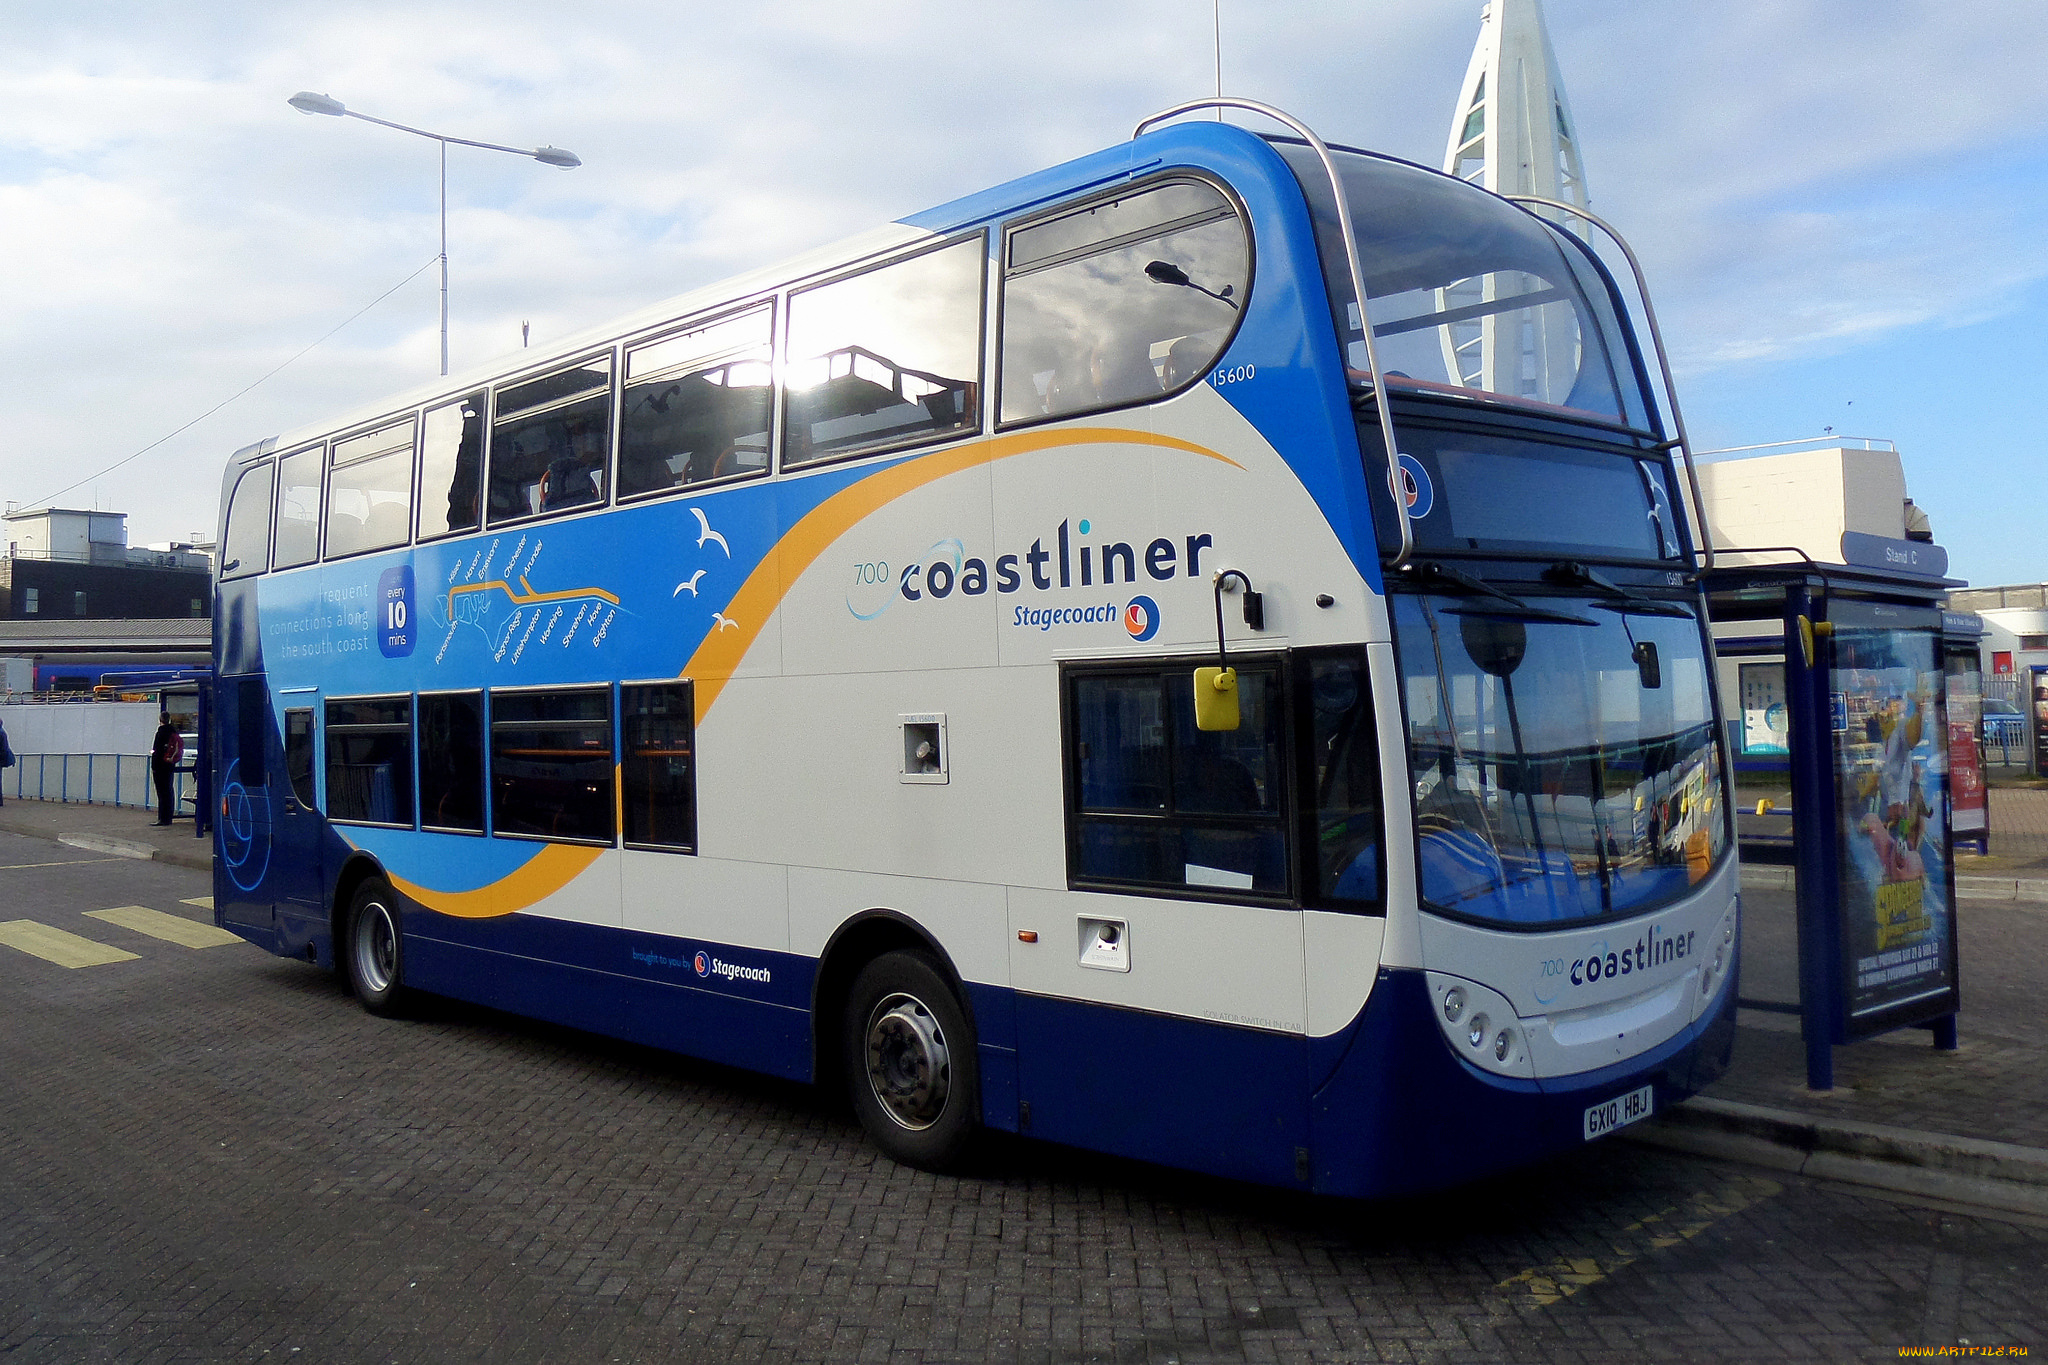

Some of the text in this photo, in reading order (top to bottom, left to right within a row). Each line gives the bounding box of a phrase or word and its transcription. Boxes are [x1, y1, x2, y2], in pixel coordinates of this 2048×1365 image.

[1213, 363, 1255, 387] 15600
[465, 550, 481, 582] Havant
[478, 538, 500, 580] Emsworth
[503, 534, 527, 579] Chichester
[524, 539, 543, 577] Arundel
[853, 517, 1214, 602] 700 coastliner
[1886, 547, 1918, 565] Stand C
[320, 582, 368, 606] frequent
[387, 586, 406, 599] every
[270, 606, 368, 635] connections along
[388, 601, 408, 629] 10
[539, 605, 563, 645] Worthing
[562, 603, 588, 648] Shoreham
[587, 602, 602, 627] Hove
[592, 609, 616, 648] Brighton
[1013, 602, 1118, 632] Stagecoach
[281, 632, 368, 658] the south coast
[388, 633, 407, 646] mins
[435, 620, 459, 665] Portsmouth
[494, 632, 511, 663] Bognor
[511, 608, 542, 665] Littlehampton
[632, 947, 771, 983] brought to you by Stagecoach
[1541, 925, 1695, 986] 700 coastliner
[1241, 1016, 1271, 1027] SWITCH
[1284, 1022, 1301, 1032] CAB
[1589, 1090, 1648, 1133] GX10 HBJ
